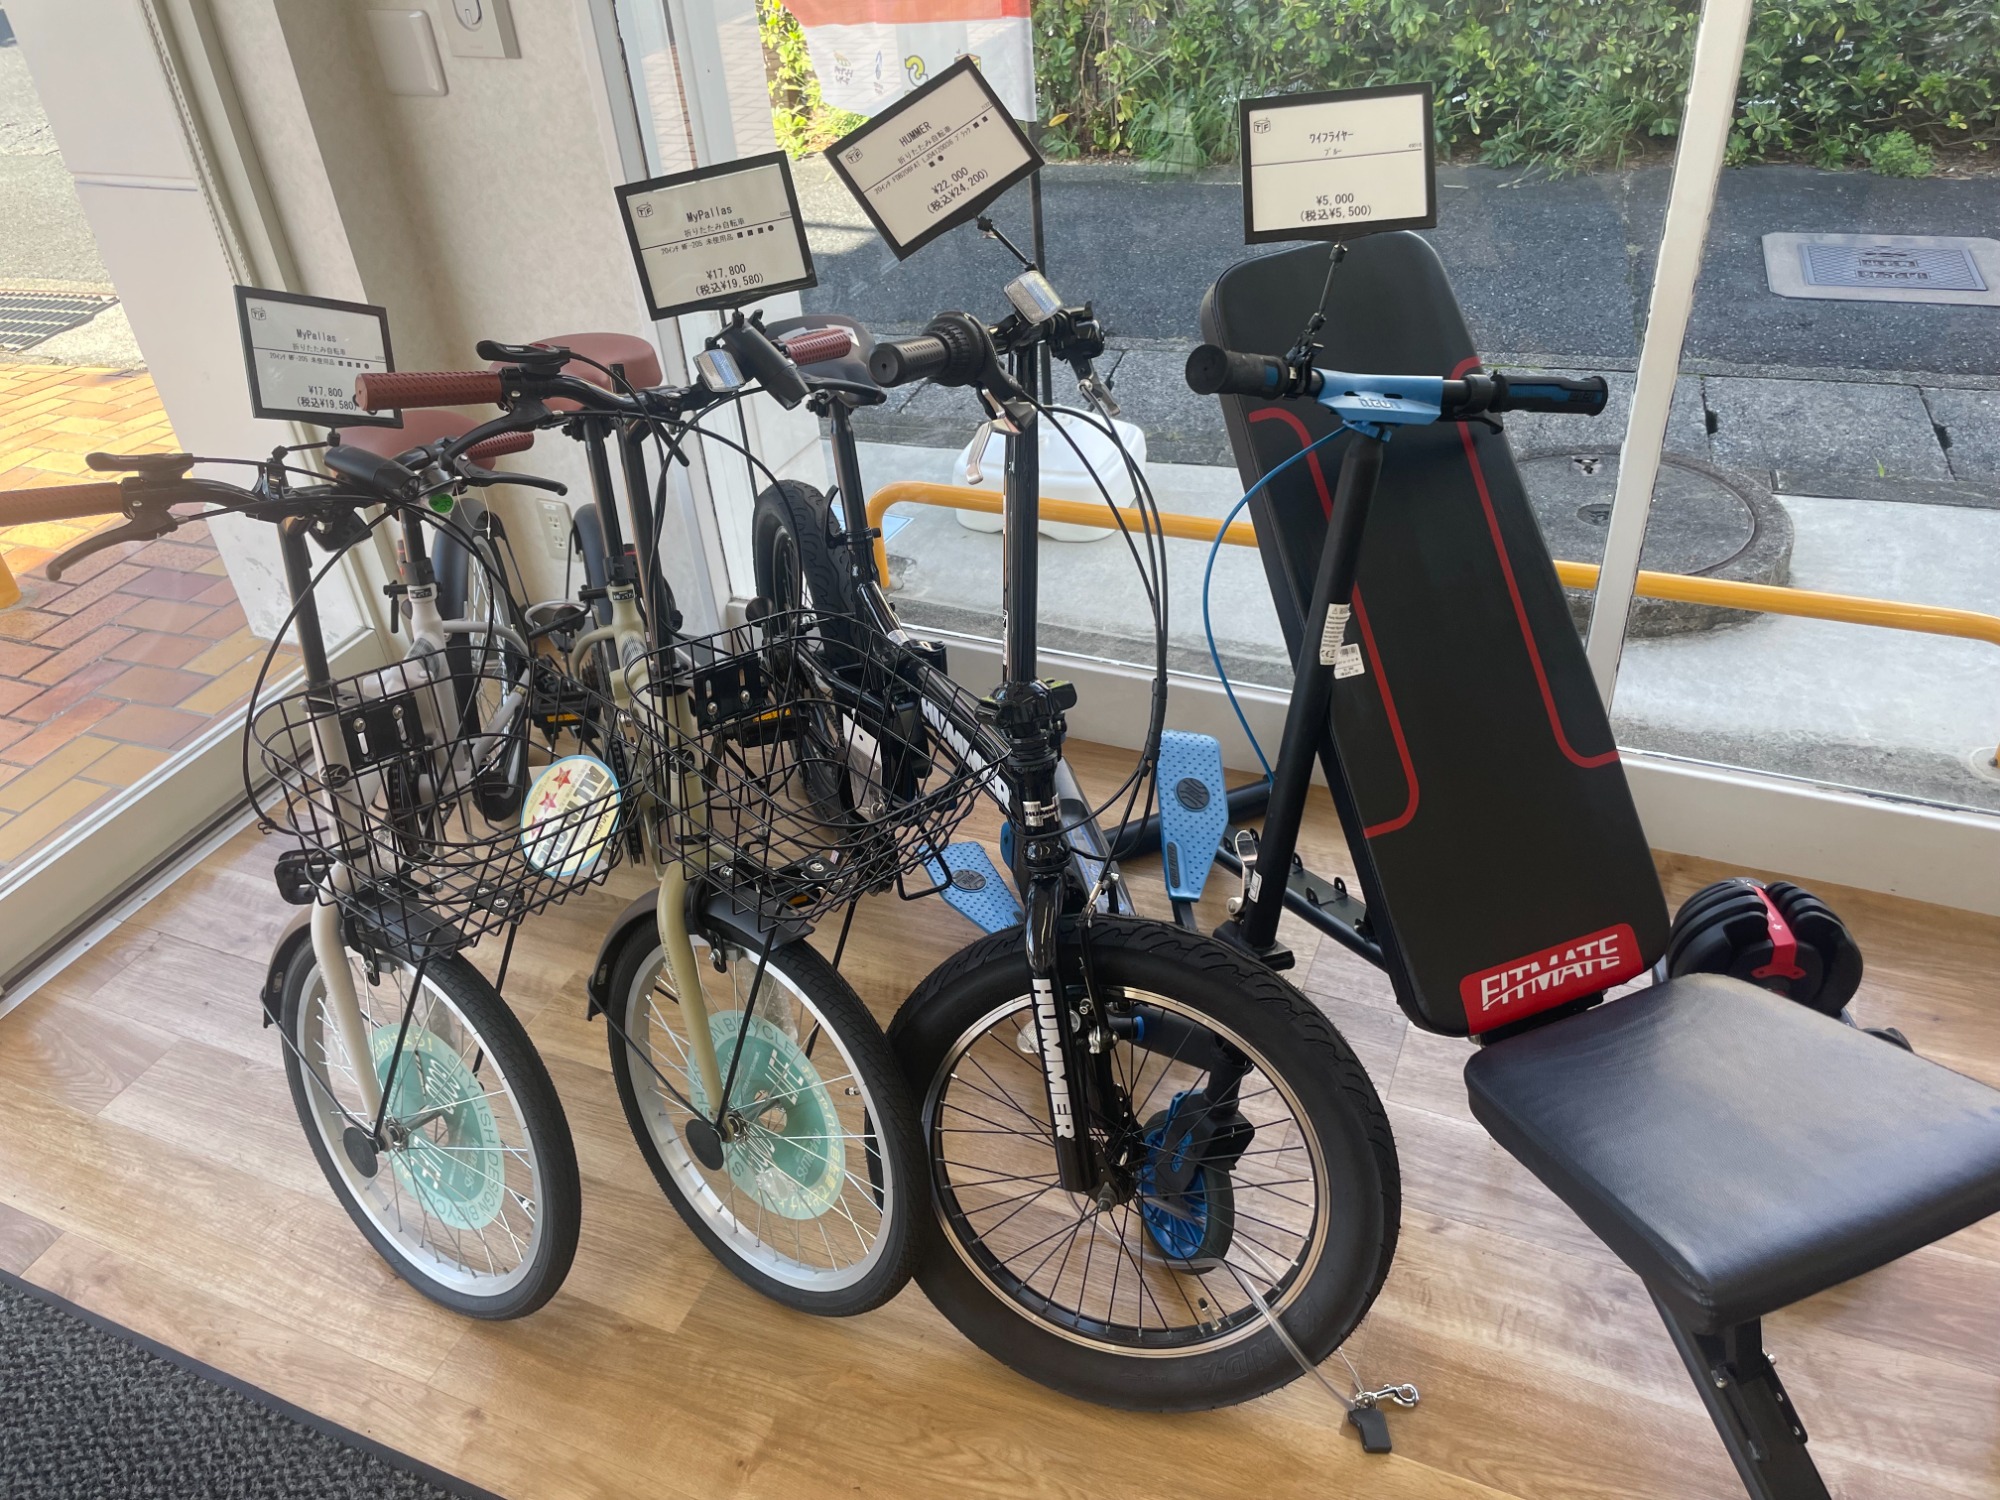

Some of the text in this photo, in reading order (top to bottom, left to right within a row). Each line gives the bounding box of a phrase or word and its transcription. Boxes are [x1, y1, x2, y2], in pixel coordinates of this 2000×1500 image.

[898, 125, 952, 164] 折りたたみ自転車
[899, 121, 932, 147] HUMMER
[927, 168, 988, 214] (税込¥24,200)
[931, 166, 969, 195] ¥22,000
[1316, 193, 1354, 206] ¥5,000
[686, 206, 732, 223] MyPallas
[1301, 205, 1372, 222] (税込¥5,500)
[684, 218, 745, 238] 折りたたみ自転車
[706, 234, 734, 245] 未使用品
[706, 264, 746, 280] ¥17,800
[696, 273, 764, 297] (税込¥19,580)
[296, 329, 336, 342] MyPallas
[292, 343, 346, 355] 折りたたみ自転車
[297, 396, 357, 411] (税込¥19,580)
[308, 385, 342, 397] ¥17,800
[573, 765, 605, 803] ALL
[1480, 933, 1620, 1012] FITMATE
[1032, 978, 1076, 1139] HUMMER
[425, 1059, 462, 1115] GOOD
[764, 1049, 804, 1105] LIFE
[447, 1053, 497, 1145] STYLISH
[479, 1151, 500, 1214] DESIGN
[1193, 1297, 1318, 1386] KNDA
